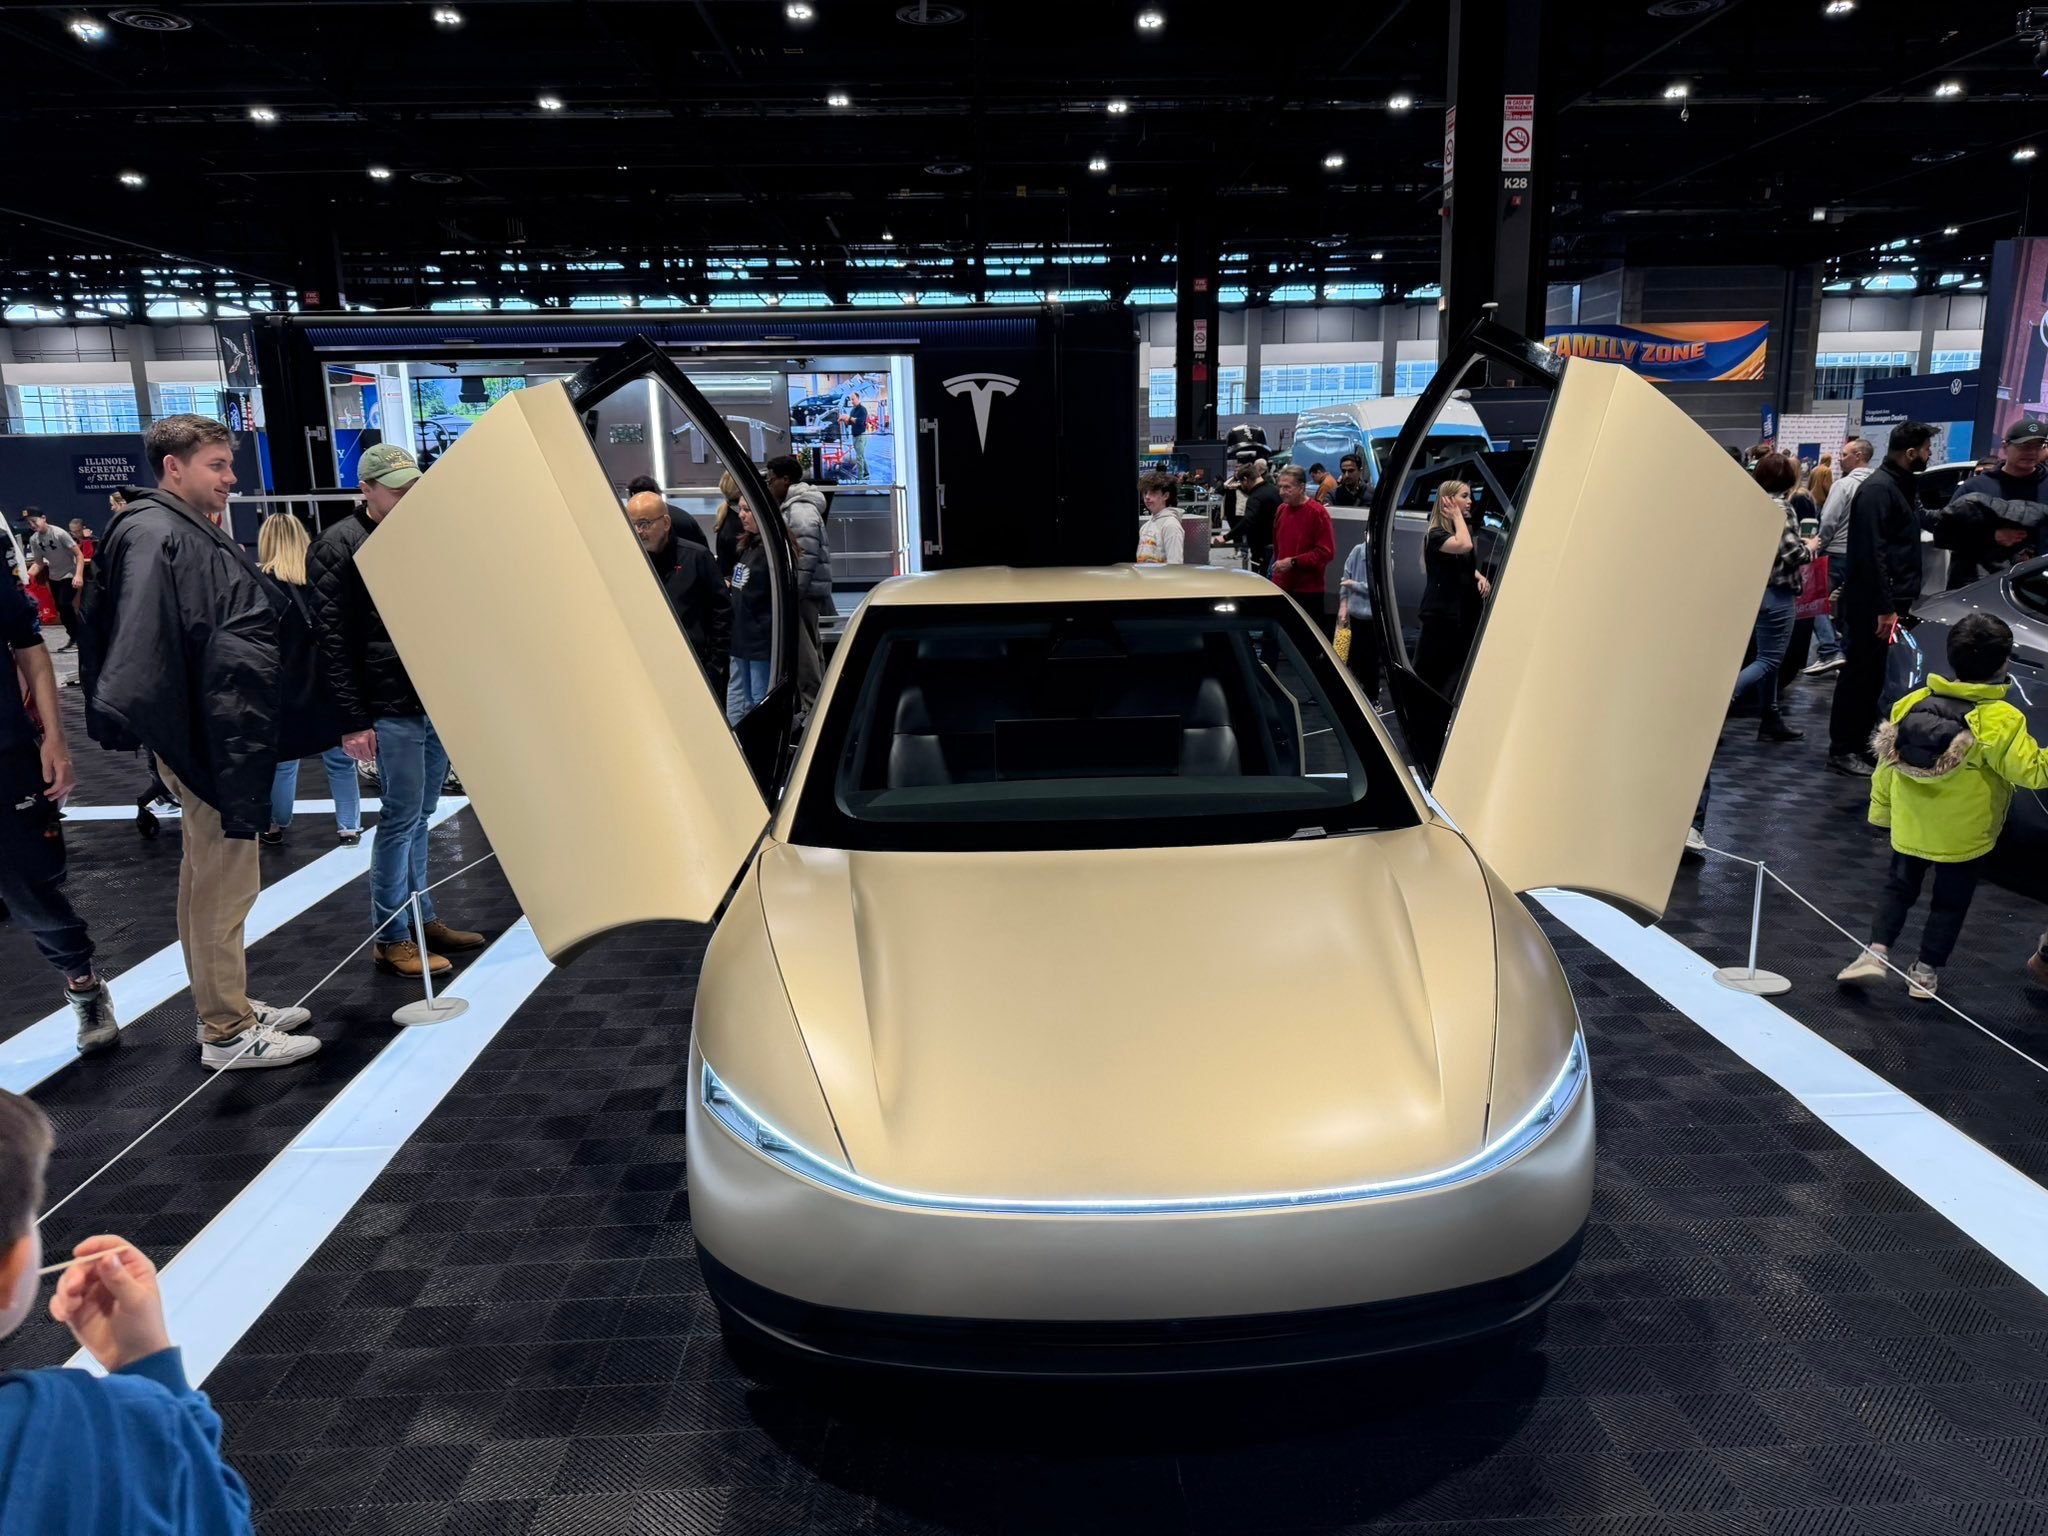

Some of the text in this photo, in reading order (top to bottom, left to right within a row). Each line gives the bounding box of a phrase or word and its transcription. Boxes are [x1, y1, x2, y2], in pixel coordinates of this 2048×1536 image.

[1504, 177, 1528, 189] K28
[1544, 333, 1706, 365] FAMILY ZONE
[1865, 415, 1890, 423] Volkswagen
[79, 465, 136, 474] SECRETARY
[87, 473, 129, 483] of STATE
